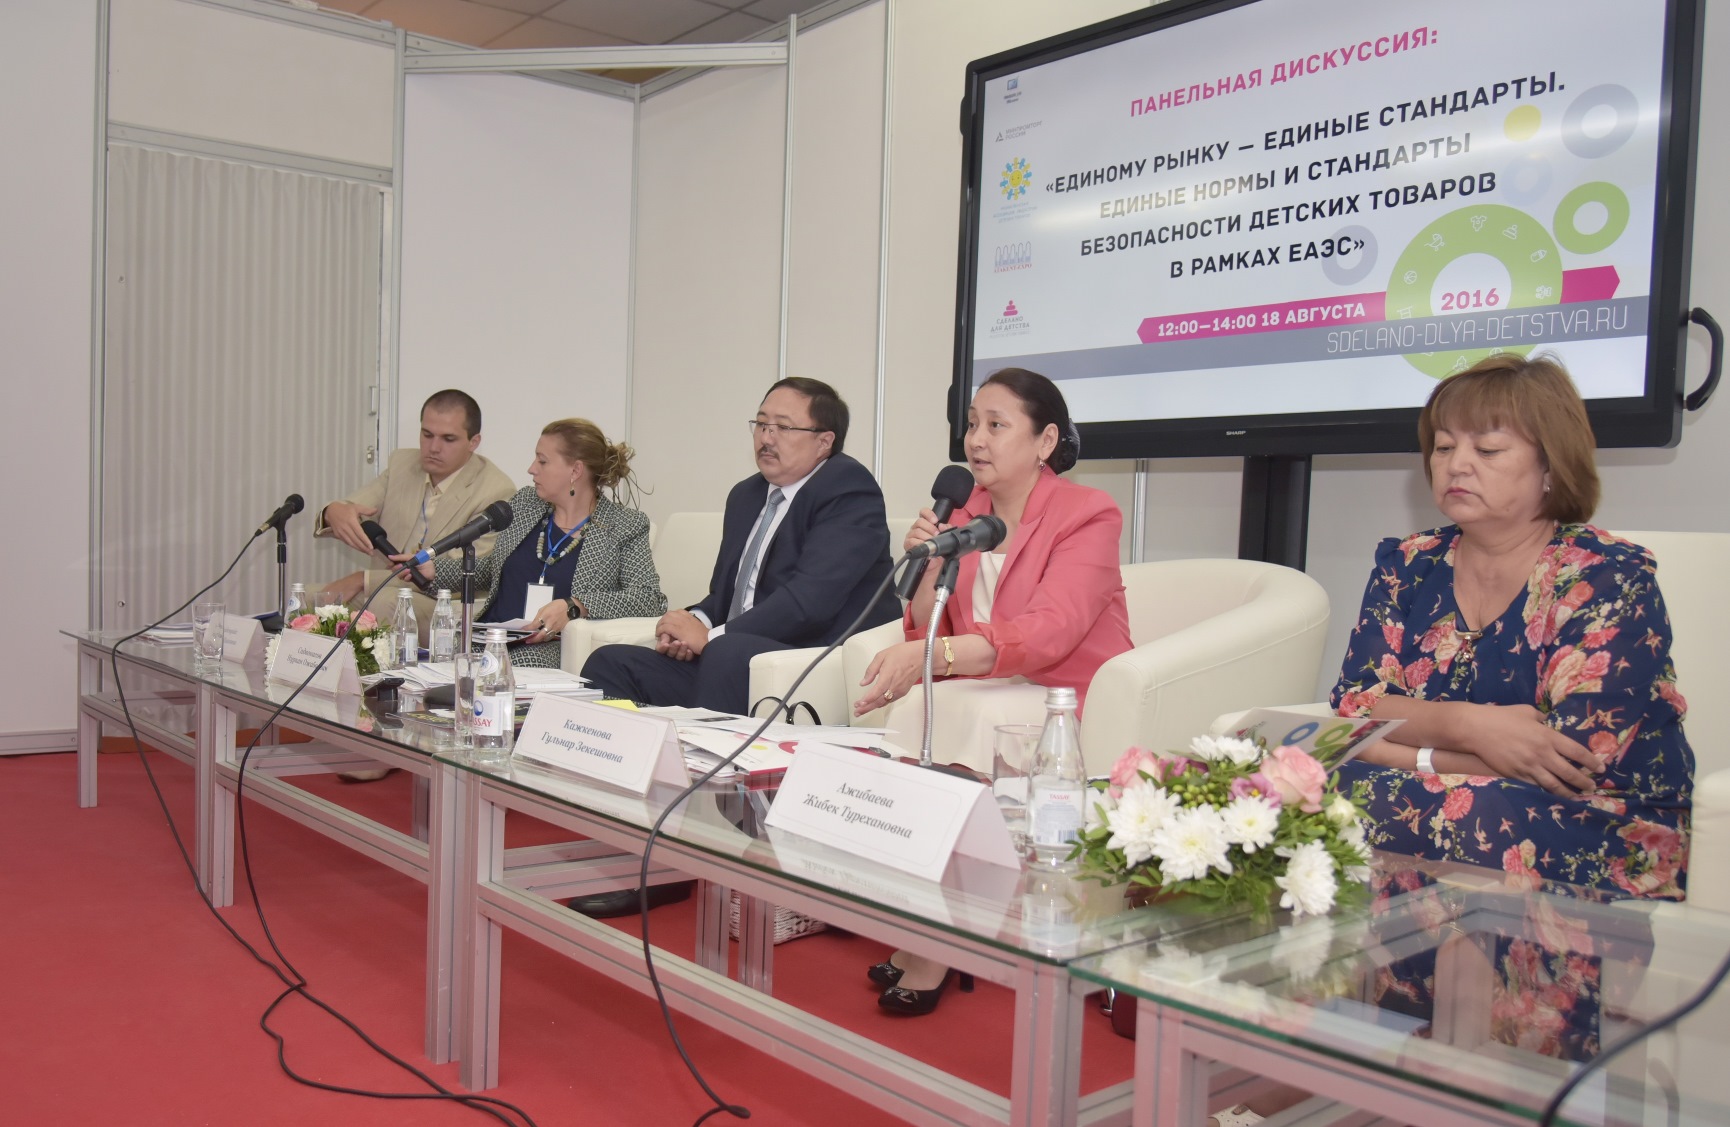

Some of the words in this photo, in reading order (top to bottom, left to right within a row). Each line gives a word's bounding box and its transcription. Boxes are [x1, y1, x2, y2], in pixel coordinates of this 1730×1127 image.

[1131, 69, 1262, 117] ПАНЕЛЬНАЯ
[1271, 27, 1438, 85] ДИСКУССИЯ:
[1046, 159, 1147, 193] «ЕДИНОМУ
[1154, 141, 1229, 172] РЫНКУ
[1265, 111, 1369, 150] ЕДИНЫЕ
[1379, 72, 1565, 126] СТАНДАРТЫ.
[1100, 187, 1186, 219] ЕДИНЫЕ
[1194, 170, 1275, 201] НОРМЫ
[1285, 166, 1299, 185] И
[1308, 133, 1471, 180] СТАНДАРТЫ
[1081, 215, 1241, 256] БЕЗОПАСНОСТИ
[1249, 194, 1360, 231] ДЕТСКИХ
[1369, 172, 1496, 210] ТОВАРОВ
[1170, 261, 1183, 278] В
[1191, 247, 1280, 276] РАМКАХ
[1289, 236, 1365, 262] ЕАЭС»
[1261, 311, 1280, 327] 18
[1285, 302, 1366, 324] АВГУСТА
[1441, 287, 1500, 312] 2016
[1327, 305, 1628, 354] SDELANO-DLYA-DETSTVA.RU
[541, 731, 576, 750] Гульнар
[576, 741, 624, 763] Зекешовна
[563, 719, 613, 741] Кажкенова
[802, 793, 840, 815] Жибек
[840, 806, 913, 839] Турехановна
[836, 782, 895, 809] Ажибаева
